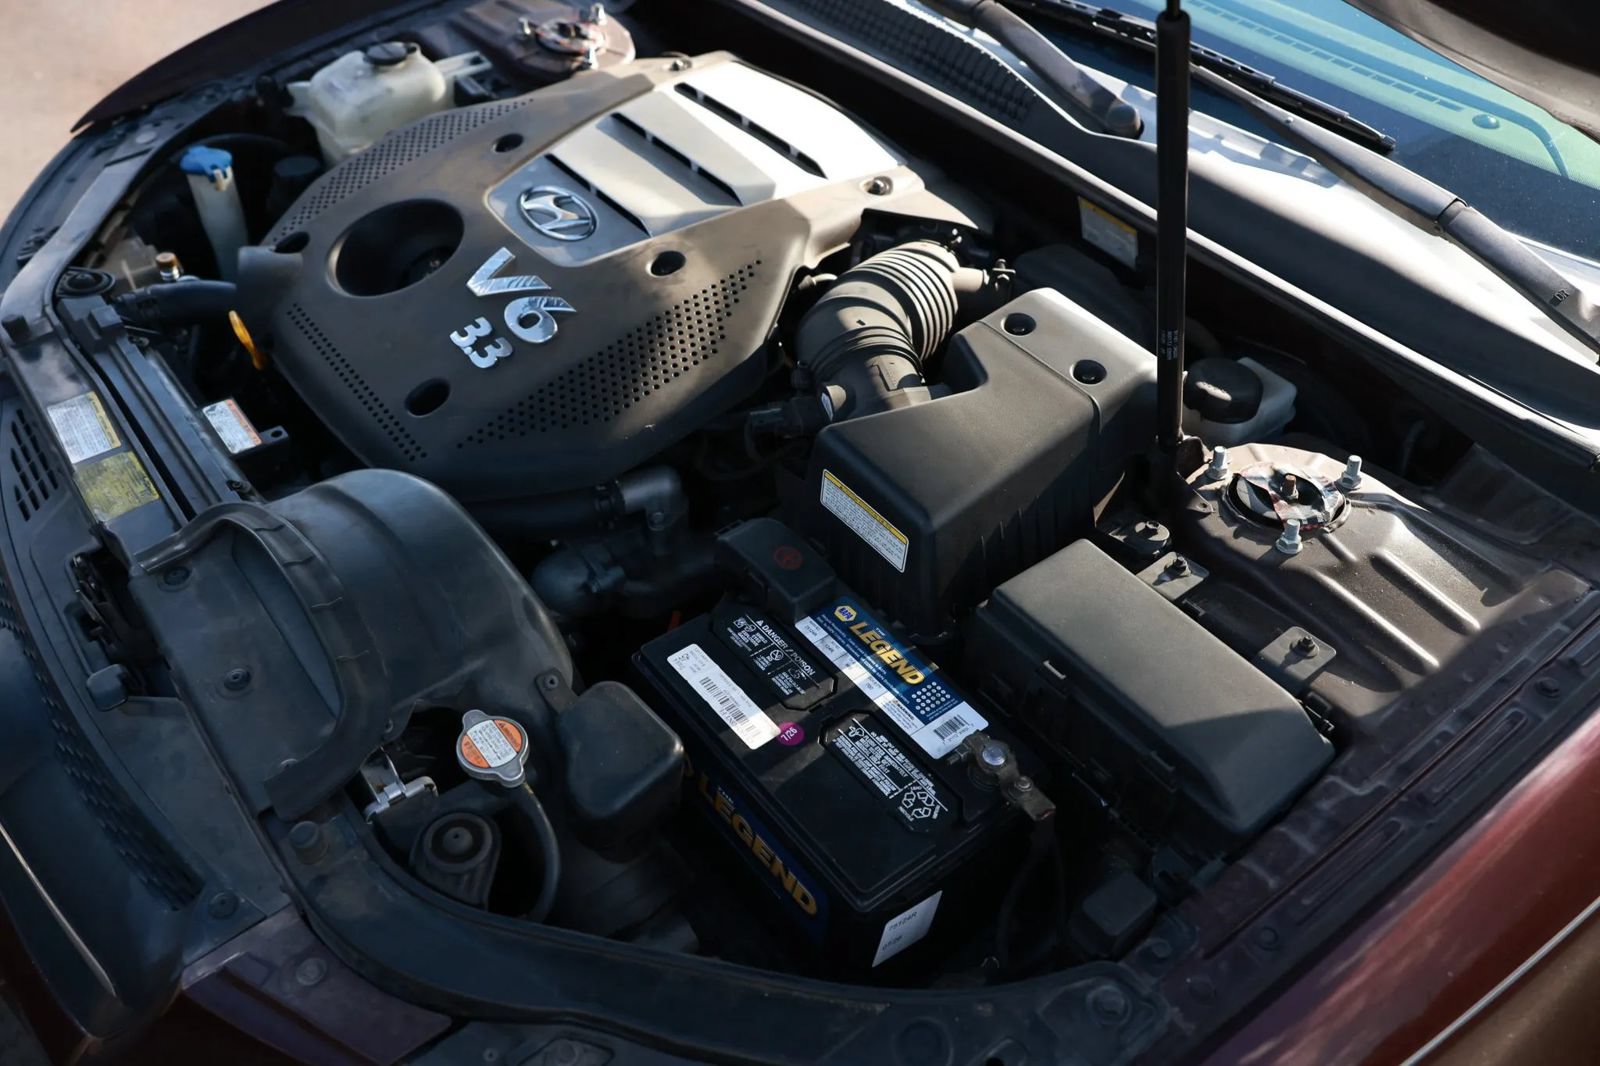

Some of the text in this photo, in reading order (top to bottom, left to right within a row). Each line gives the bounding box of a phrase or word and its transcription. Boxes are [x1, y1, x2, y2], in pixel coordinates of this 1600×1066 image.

[466, 247, 577, 343] V6
[450, 317, 513, 368] 3.3
[761, 624, 788, 649] DANGER
[790, 650, 816, 676] POISON
[848, 622, 925, 684] LEGEND
